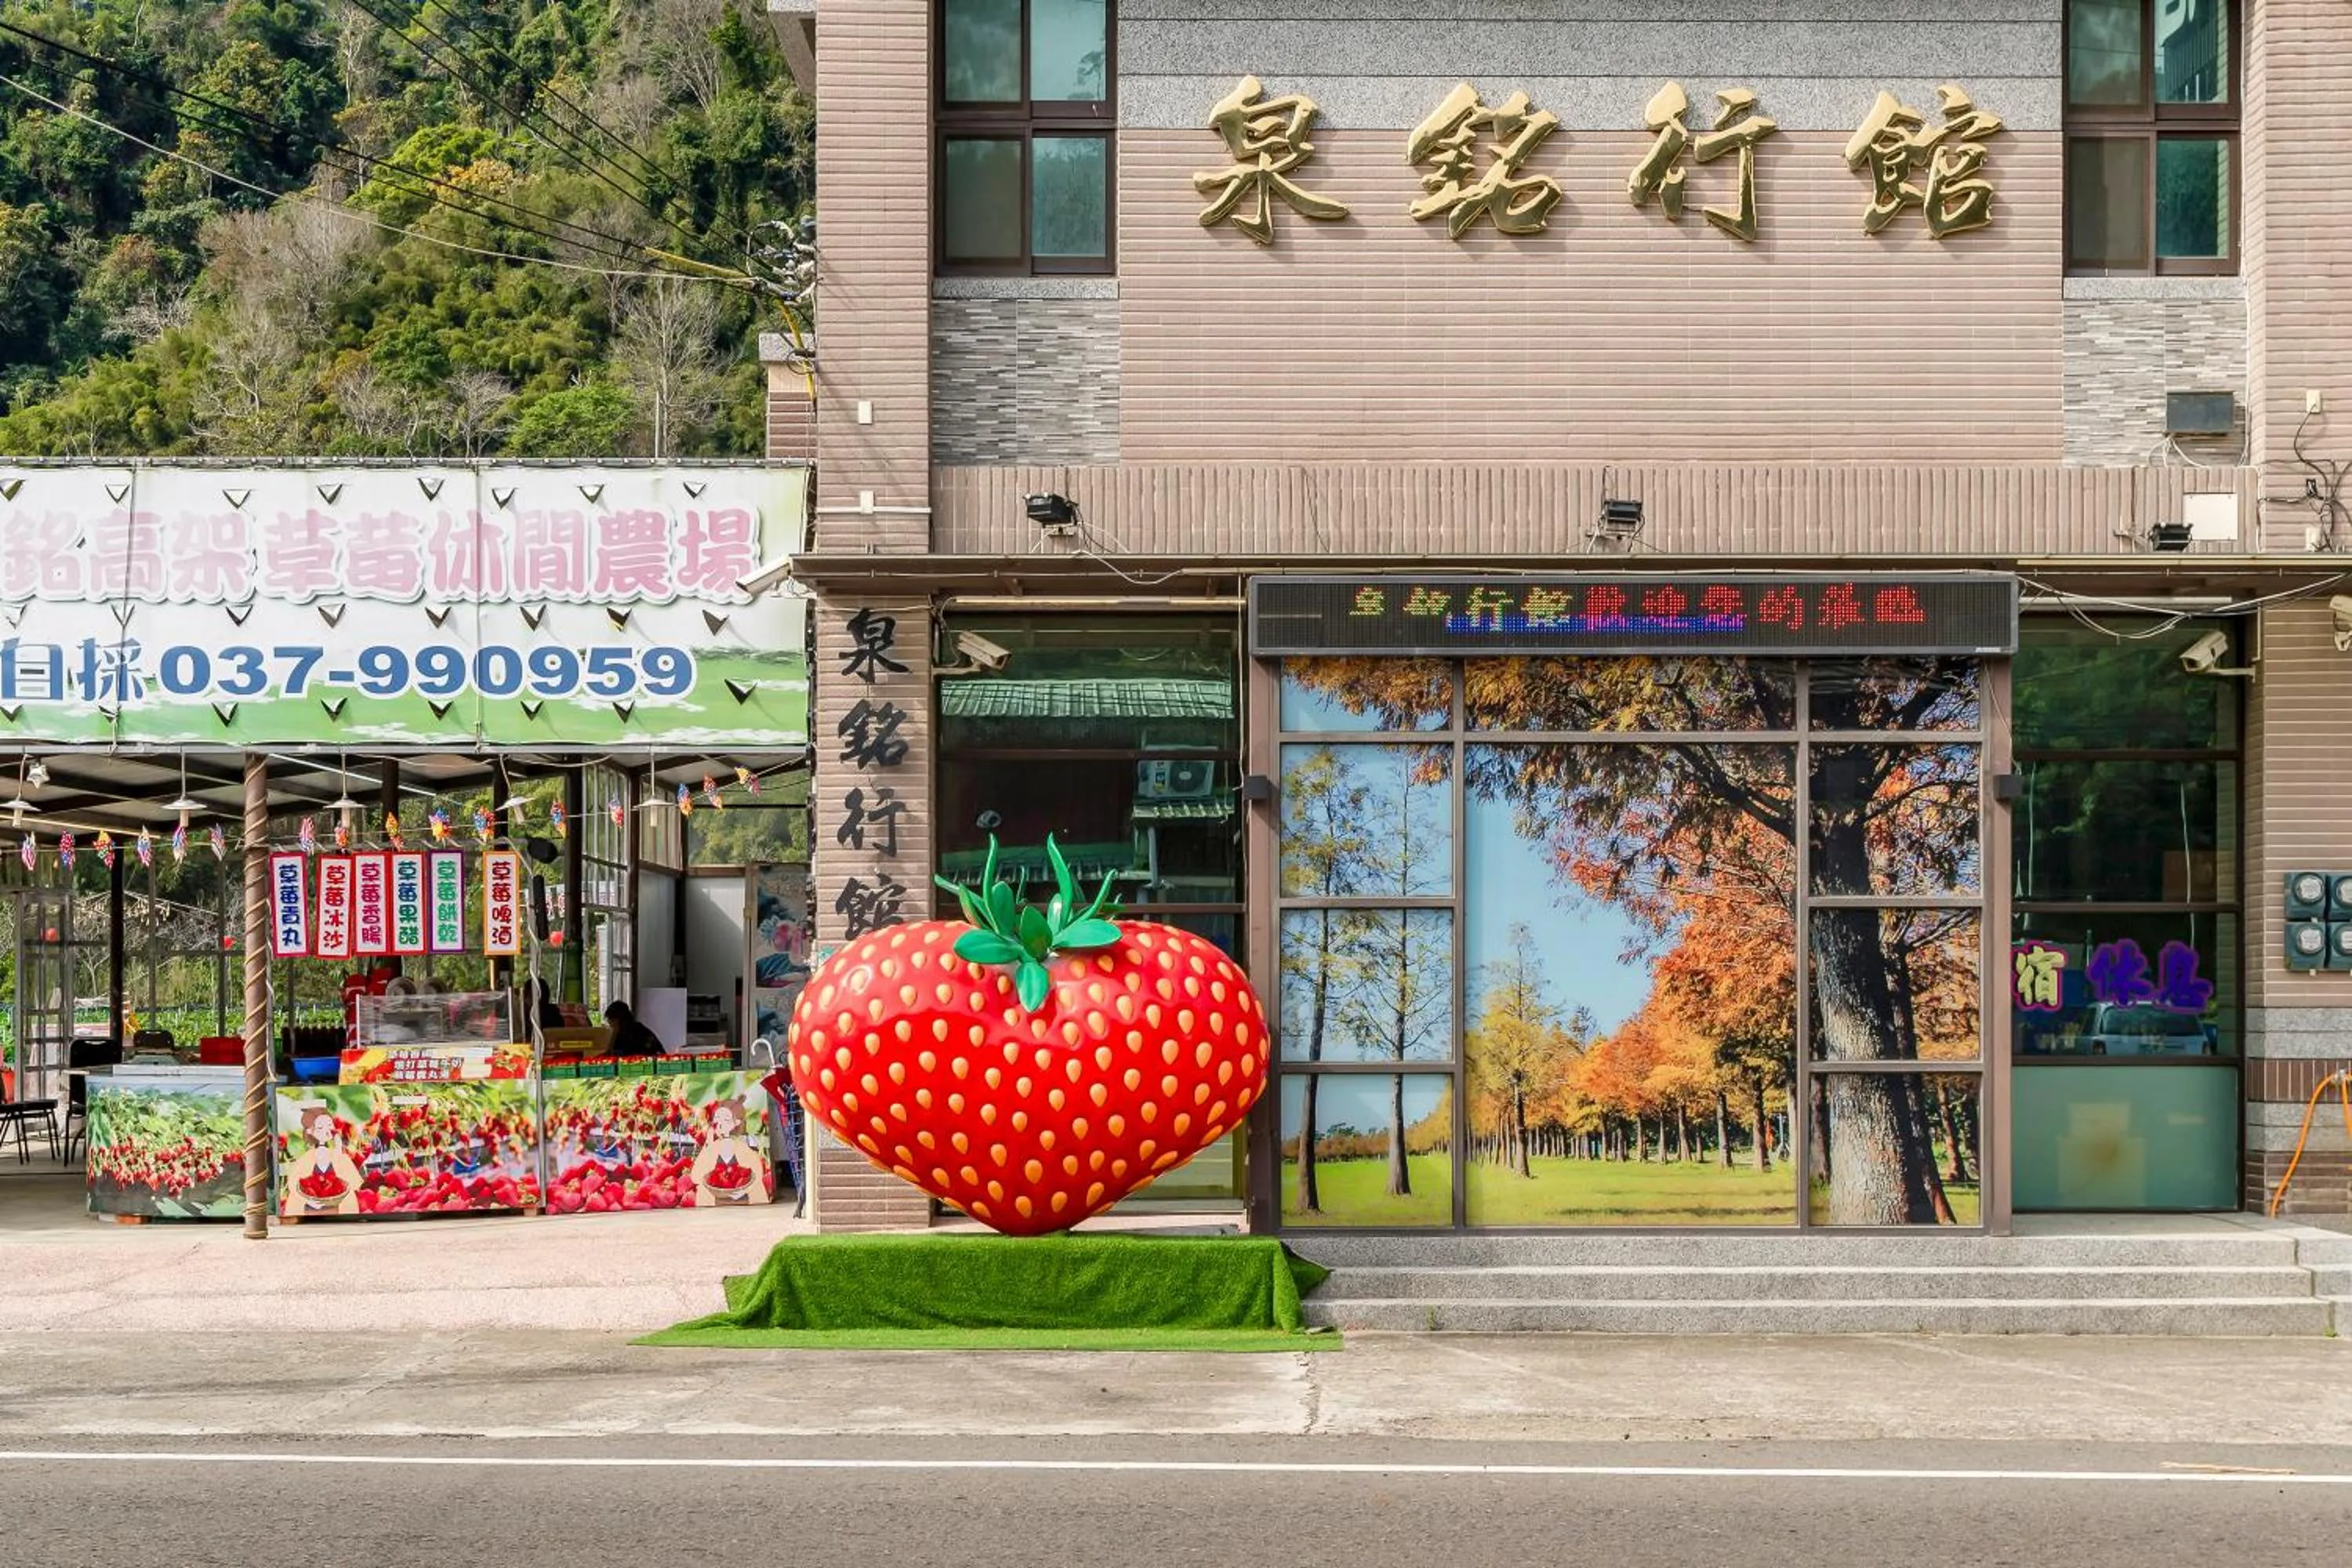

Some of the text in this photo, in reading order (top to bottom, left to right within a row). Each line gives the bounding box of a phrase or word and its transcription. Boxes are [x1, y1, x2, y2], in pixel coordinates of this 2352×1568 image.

[1192, 74, 2006, 244] 泉銘行館
[160, 646, 692, 696] 037-990959
[278, 864, 302, 946] 草莓貢丸
[323, 865, 346, 949] 草莓冰沙
[361, 862, 381, 945] 草莓香腸
[397, 861, 419, 946] 草莓果醋
[437, 861, 457, 942] 草莓餅乾
[492, 861, 512, 946] 草莓啤酒
